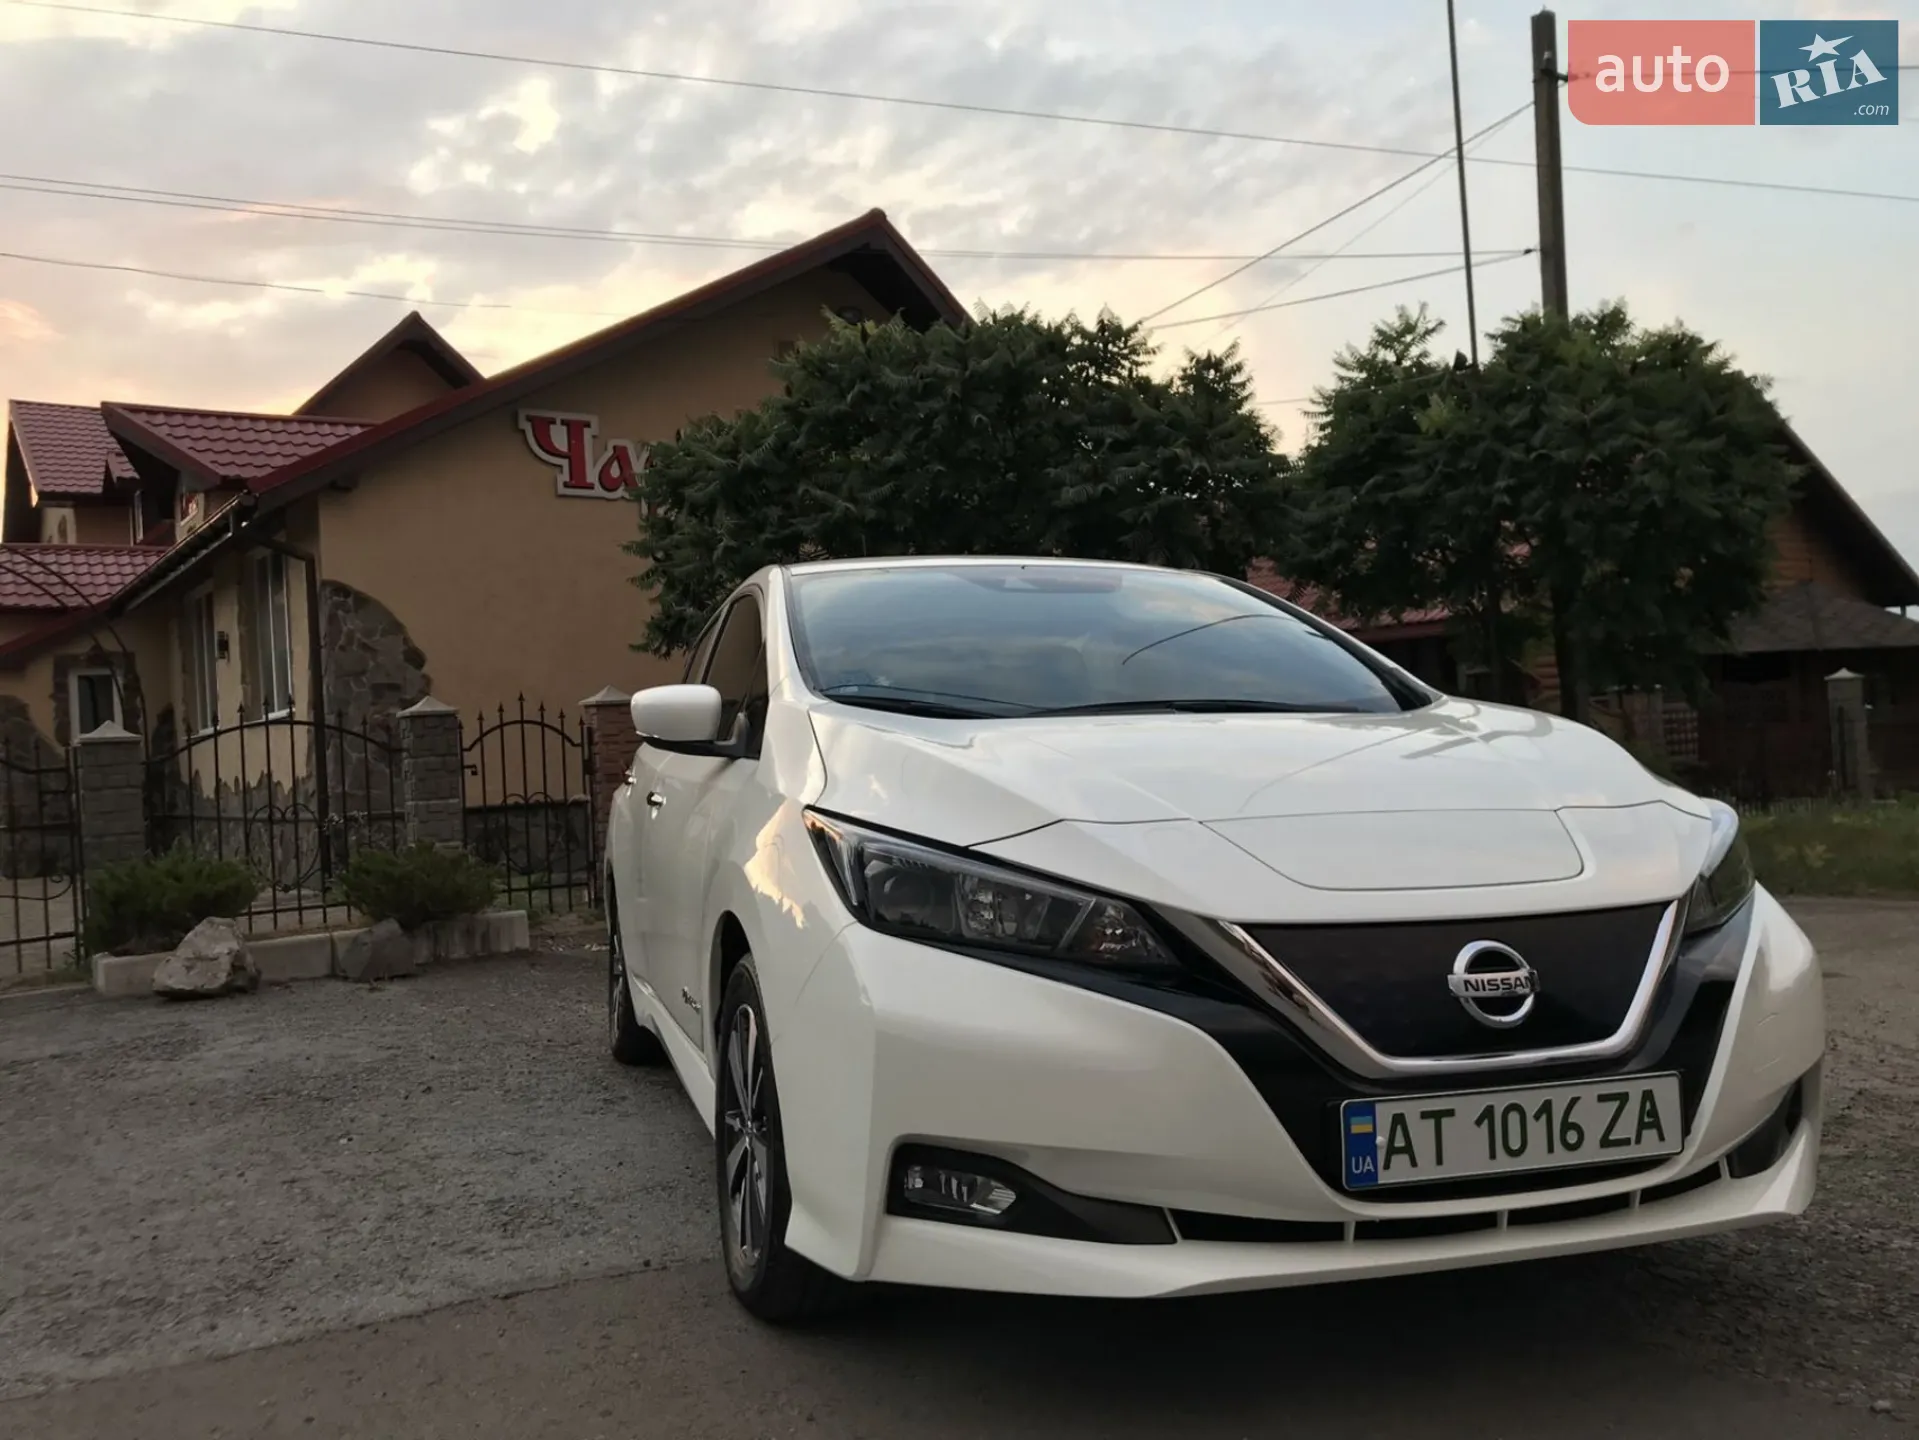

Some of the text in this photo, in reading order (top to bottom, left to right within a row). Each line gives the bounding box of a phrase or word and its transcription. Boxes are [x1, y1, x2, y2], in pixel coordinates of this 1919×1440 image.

[523, 412, 658, 514] Ча
[1463, 976, 1536, 992] NISSAN
[1383, 1089, 1666, 1170] AT 1016 ZA
[1351, 1156, 1375, 1175] UA
